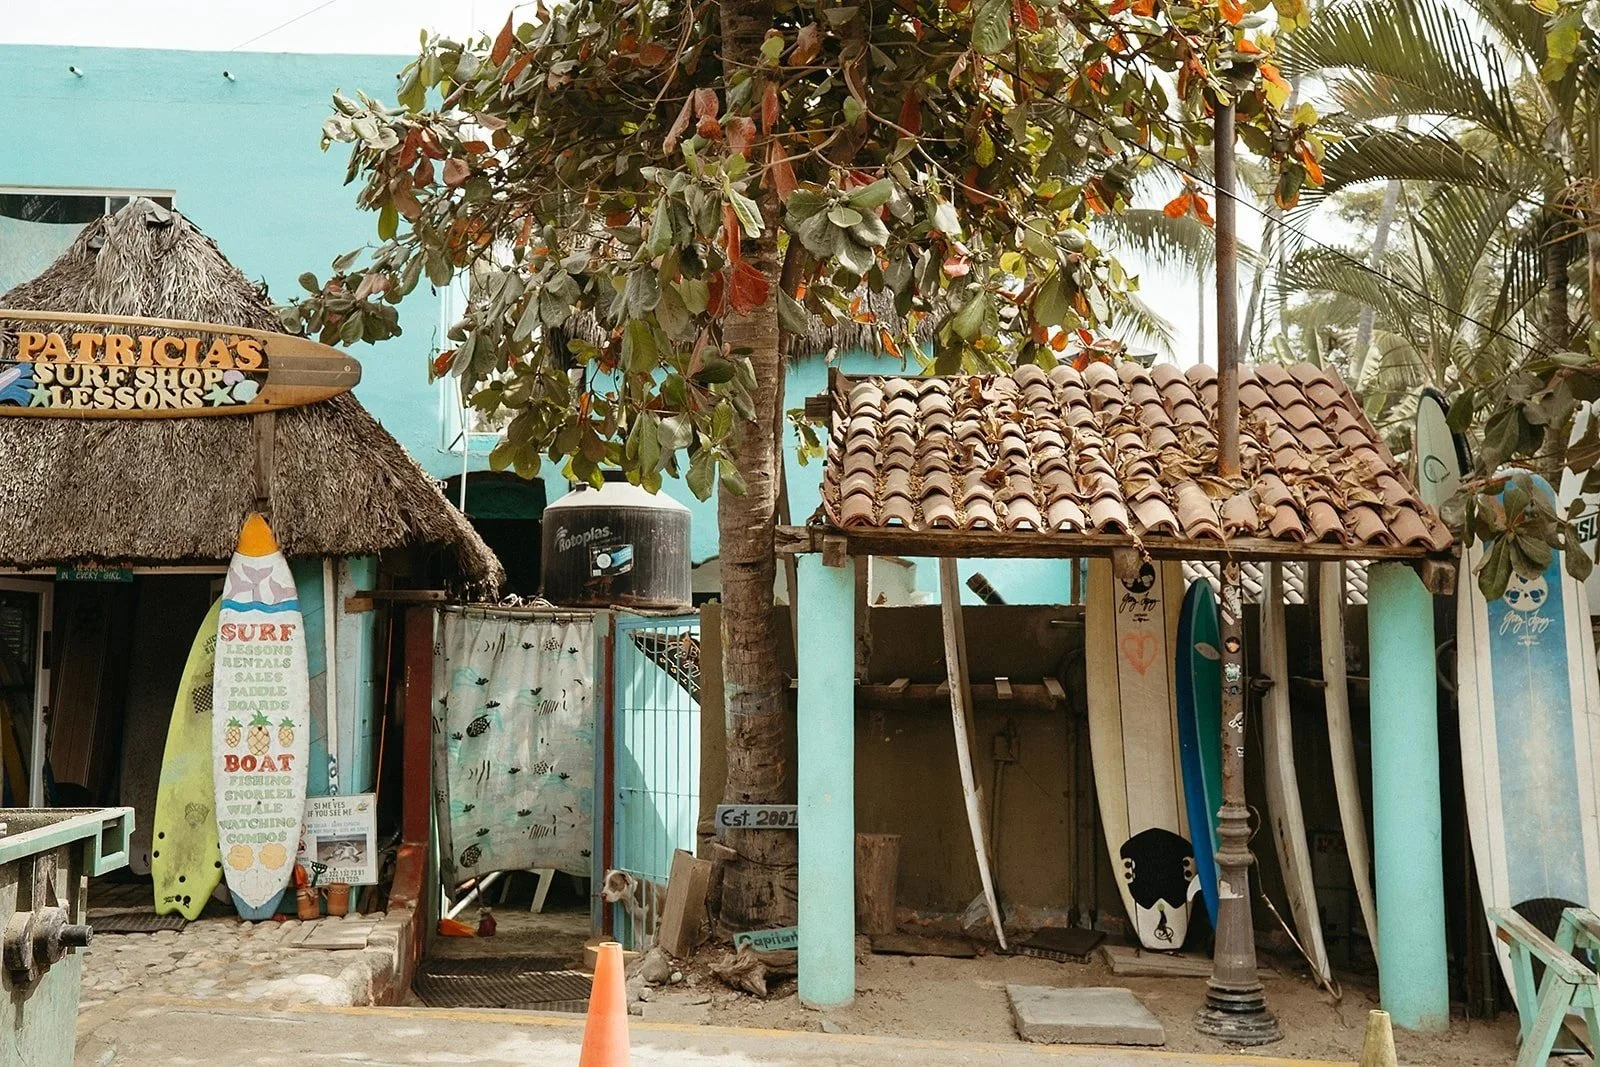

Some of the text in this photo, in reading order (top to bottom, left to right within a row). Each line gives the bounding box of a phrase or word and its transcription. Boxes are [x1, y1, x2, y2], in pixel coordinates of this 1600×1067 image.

[15, 331, 264, 370] PATRICIA'S
[32, 363, 224, 390] SURF SHOP
[49, 386, 206, 410] LESSONS
[220, 623, 297, 642] SURF
[226, 644, 293, 656] LESSONS
[222, 657, 292, 669] RENTALS
[234, 672, 283, 683] SALES
[230, 686, 288, 697] PADDLE
[228, 700, 290, 711] BOARDS
[224, 754, 295, 772] BOAT
[229, 775, 292, 786] FISHING
[225, 789, 296, 801] SNORKEL
[227, 803, 284, 816] WHALE
[219, 817, 297, 830] WATCHING
[721, 809, 798, 826] Est. 2001
[226, 831, 288, 844] COMBOS
